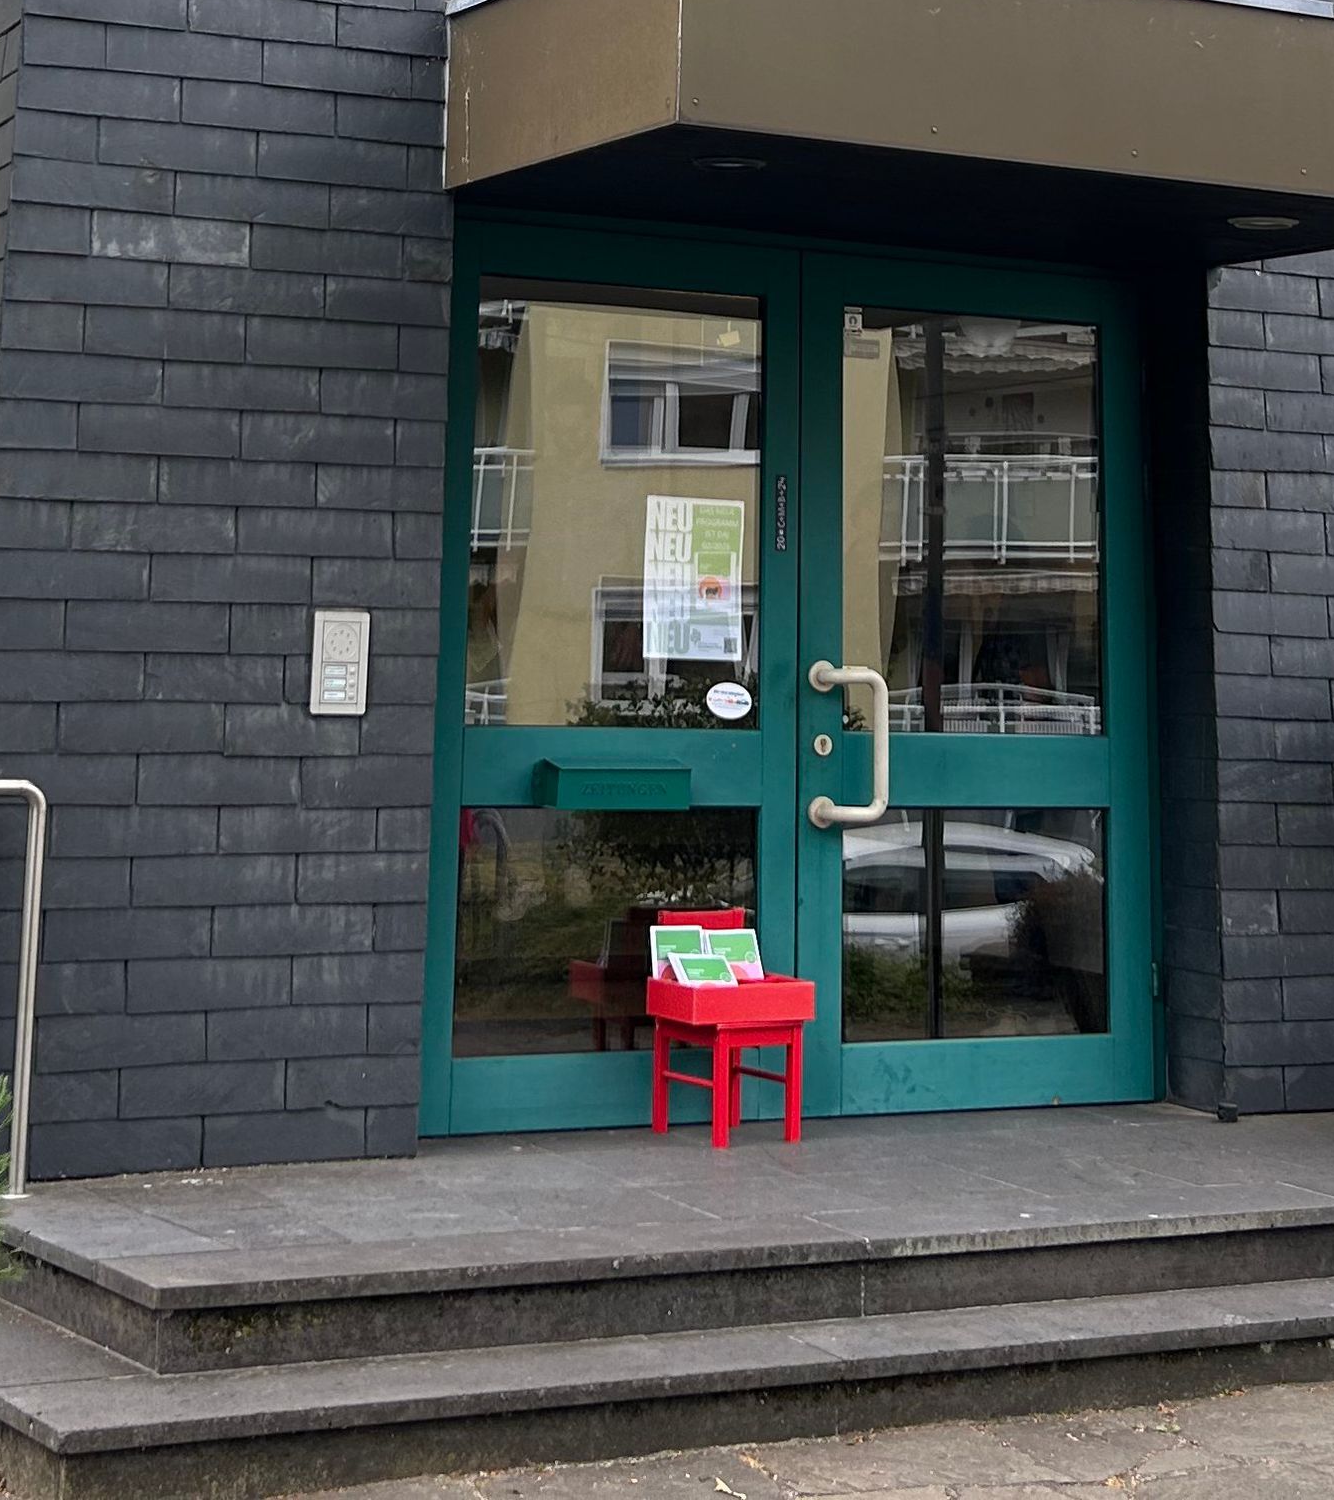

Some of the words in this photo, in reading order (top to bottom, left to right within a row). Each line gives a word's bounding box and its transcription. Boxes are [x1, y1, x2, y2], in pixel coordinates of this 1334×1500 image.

[650, 500, 693, 533] NEU
[649, 531, 692, 563] NEU
[646, 620, 691, 654] NEU
